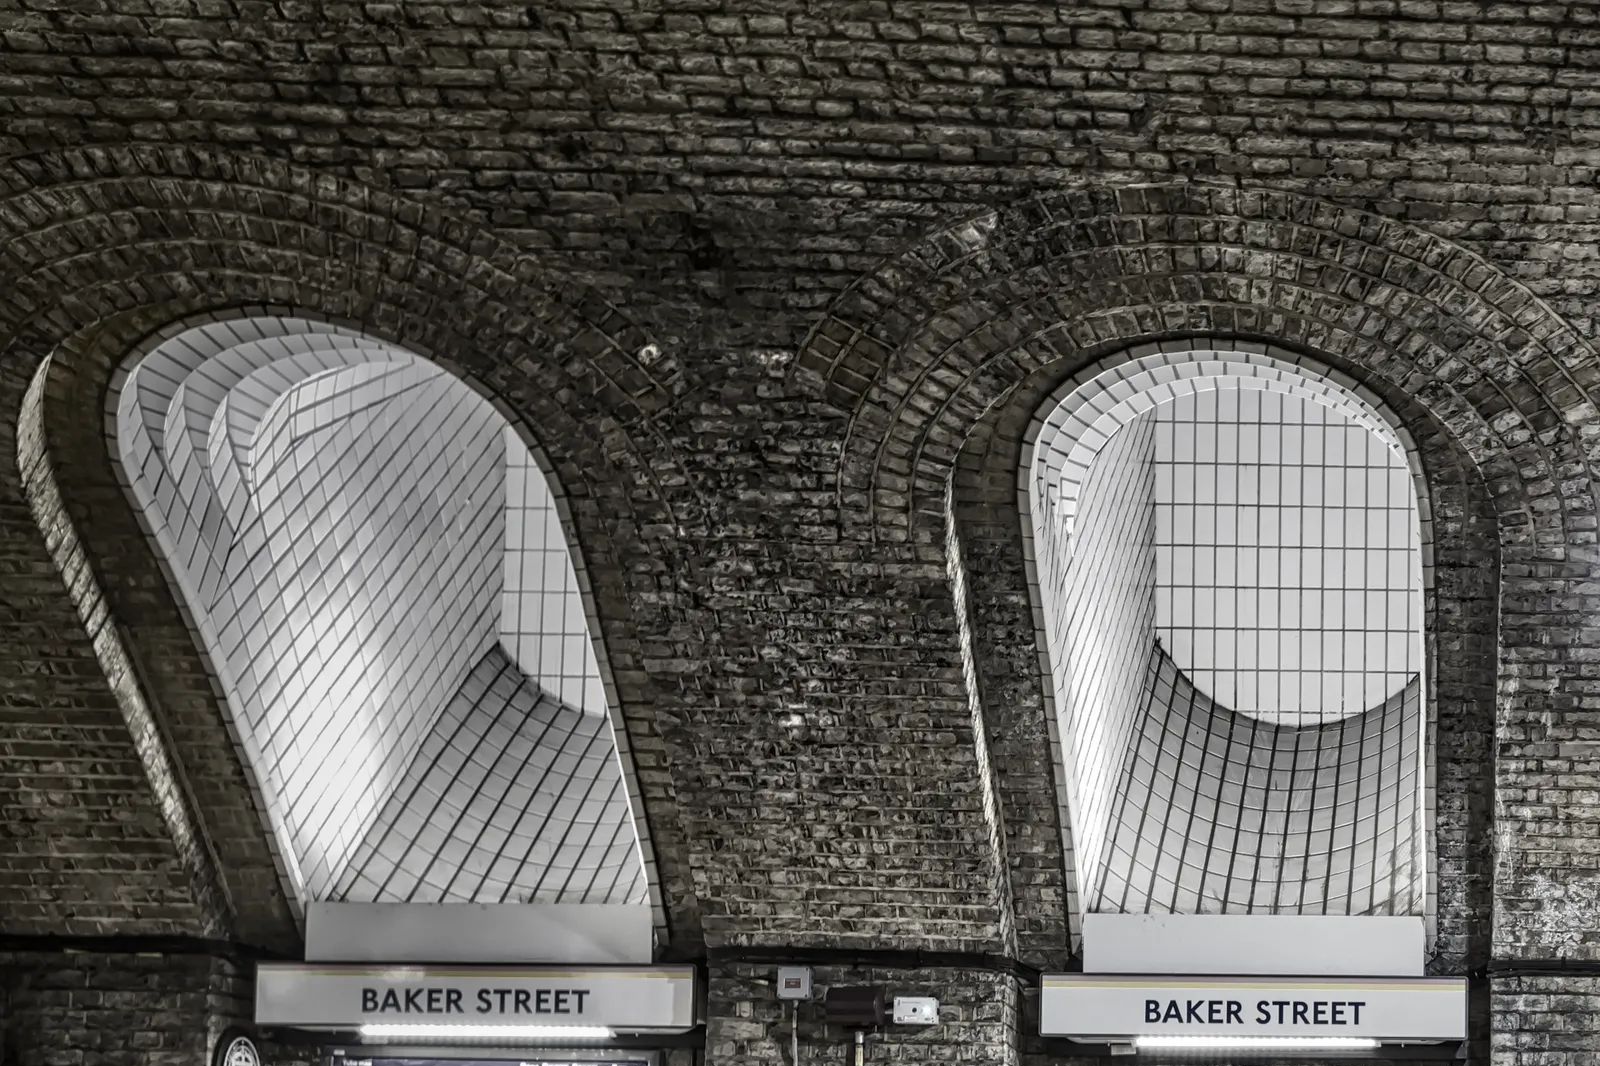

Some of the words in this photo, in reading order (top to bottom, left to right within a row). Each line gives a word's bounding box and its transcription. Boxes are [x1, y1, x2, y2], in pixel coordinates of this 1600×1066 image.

[361, 987, 465, 1014] BAKER
[475, 988, 590, 1015] STREET
[1144, 999, 1244, 1024] BAKER
[1255, 1000, 1366, 1026] STREET
